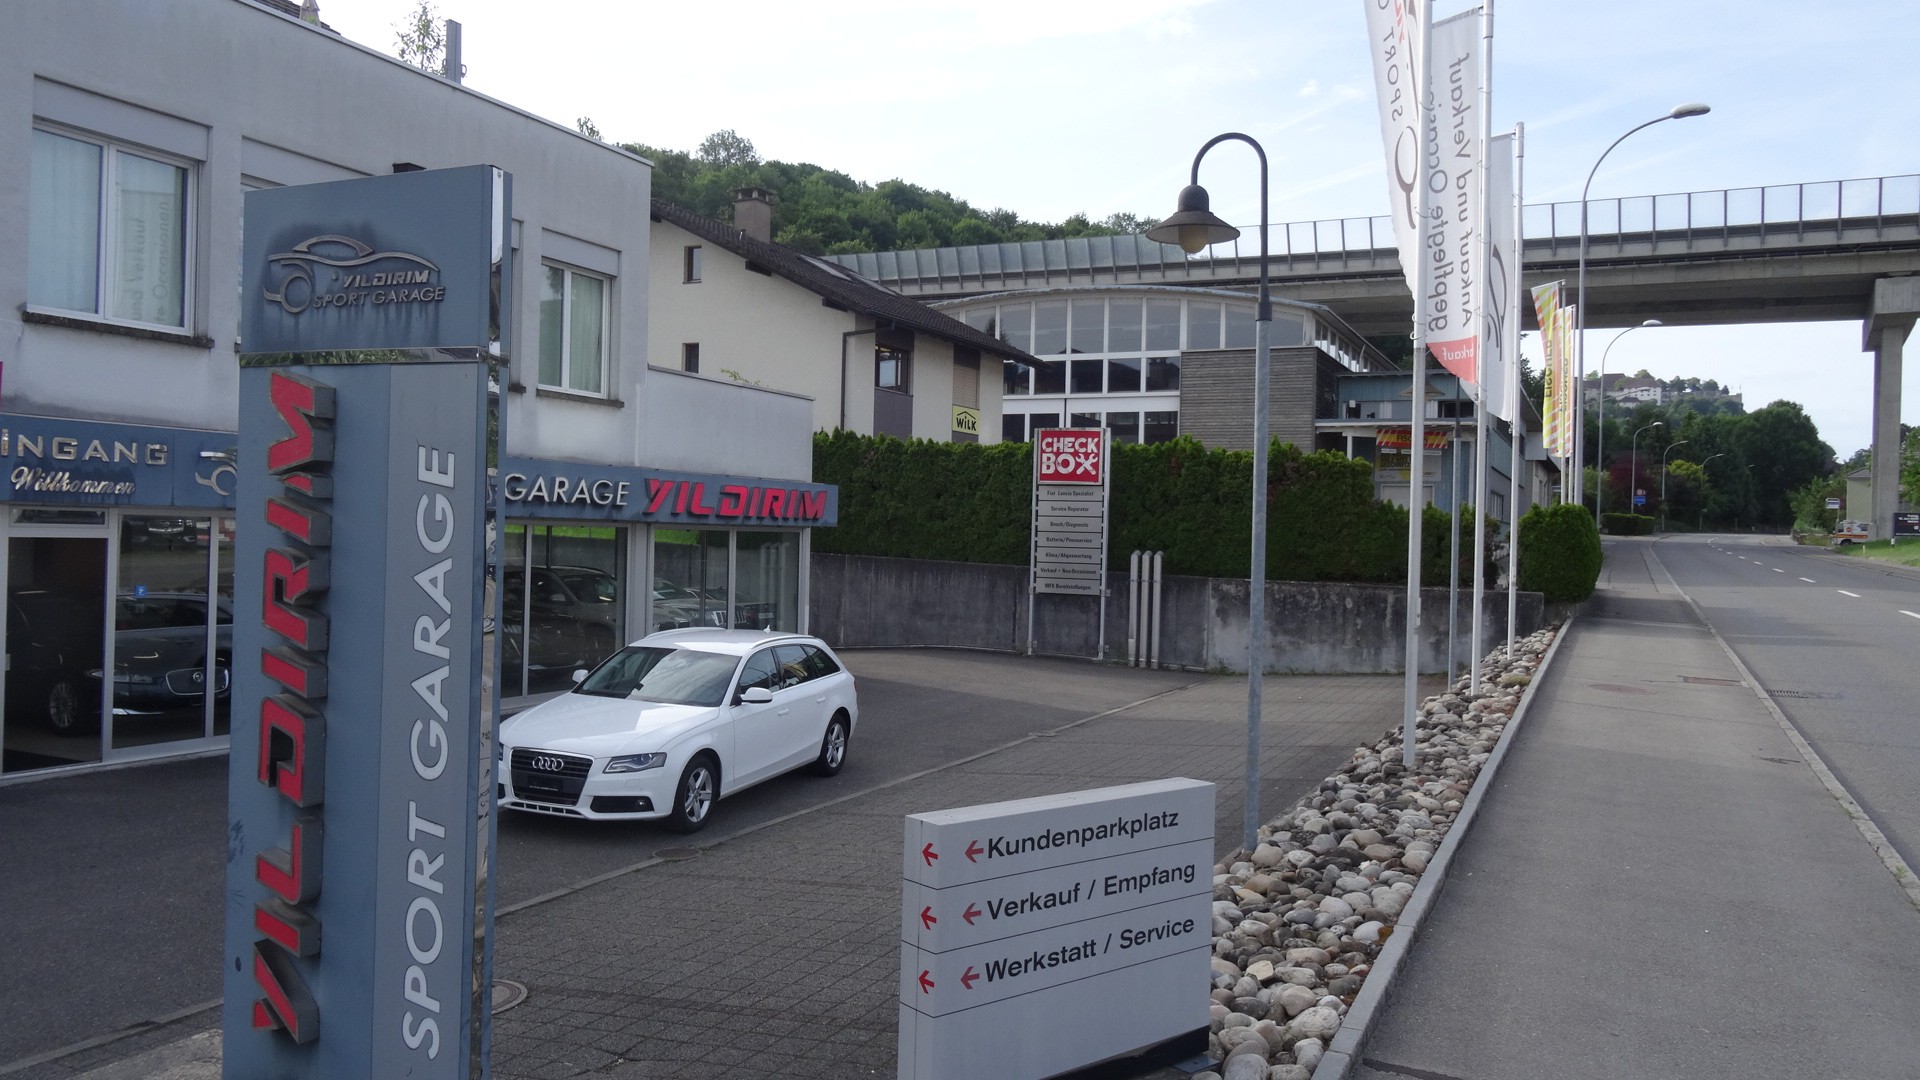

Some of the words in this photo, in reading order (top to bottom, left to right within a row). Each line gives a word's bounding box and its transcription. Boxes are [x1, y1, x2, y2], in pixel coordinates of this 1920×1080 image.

[312, 291, 368, 309] SPORT
[371, 286, 446, 305] GARAGE
[342, 269, 430, 288] YILDIRIM
[1041, 437, 1099, 453] CHECK
[1041, 453, 1099, 475] BOX
[11, 465, 136, 495] Willkommen
[504, 473, 631, 506] GARAGE
[645, 478, 828, 520] YILDIRIM
[410, 444, 456, 781] GARAGE
[252, 370, 332, 1044] YILDIRIM
[987, 811, 1179, 859] Kundenparkplatz
[987, 883, 1081, 920] Verkauf
[1086, 879, 1096, 900] /
[1103, 864, 1196, 896] Empfang
[402, 799, 447, 1061] SPORT
[985, 939, 1097, 982] Werkstatt
[1103, 933, 1112, 953] /
[1119, 918, 1195, 949] Service
